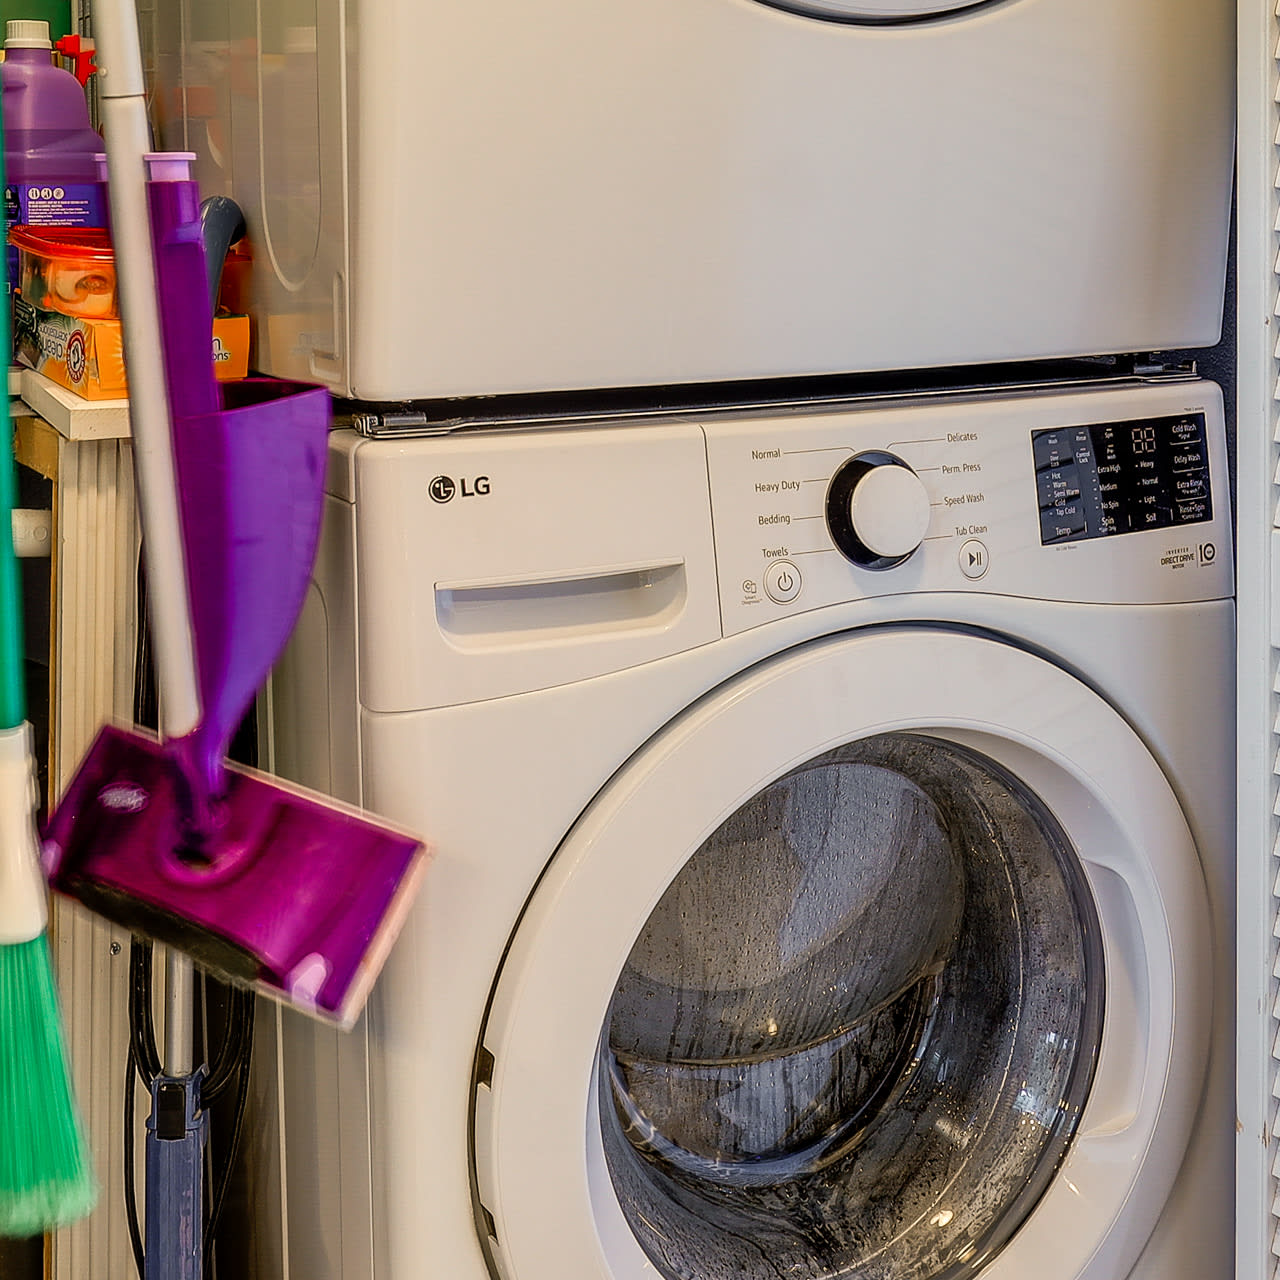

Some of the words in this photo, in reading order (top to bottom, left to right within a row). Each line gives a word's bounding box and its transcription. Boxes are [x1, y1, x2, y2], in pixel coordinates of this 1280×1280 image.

[947, 432, 978, 443] Delicates
[752, 448, 780, 460] Normal
[942, 464, 961, 475] Perm.
[963, 463, 981, 472] Press
[460, 476, 490, 497] LG
[755, 482, 779, 493] Heavy
[782, 480, 800, 492] Duty
[944, 495, 965, 507] Speed
[966, 493, 985, 503] Wash
[759, 514, 790, 525] Bedding
[1101, 516, 1114, 527] Spin
[1145, 513, 1157, 522] Soil
[956, 527, 968, 536] Tub
[969, 525, 988, 535] Clean
[762, 547, 788, 558] Towels
[1199, 543, 1216, 562] 10
[1161, 556, 1179, 565] DIRECT
[1179, 553, 1195, 563] DRIVE
